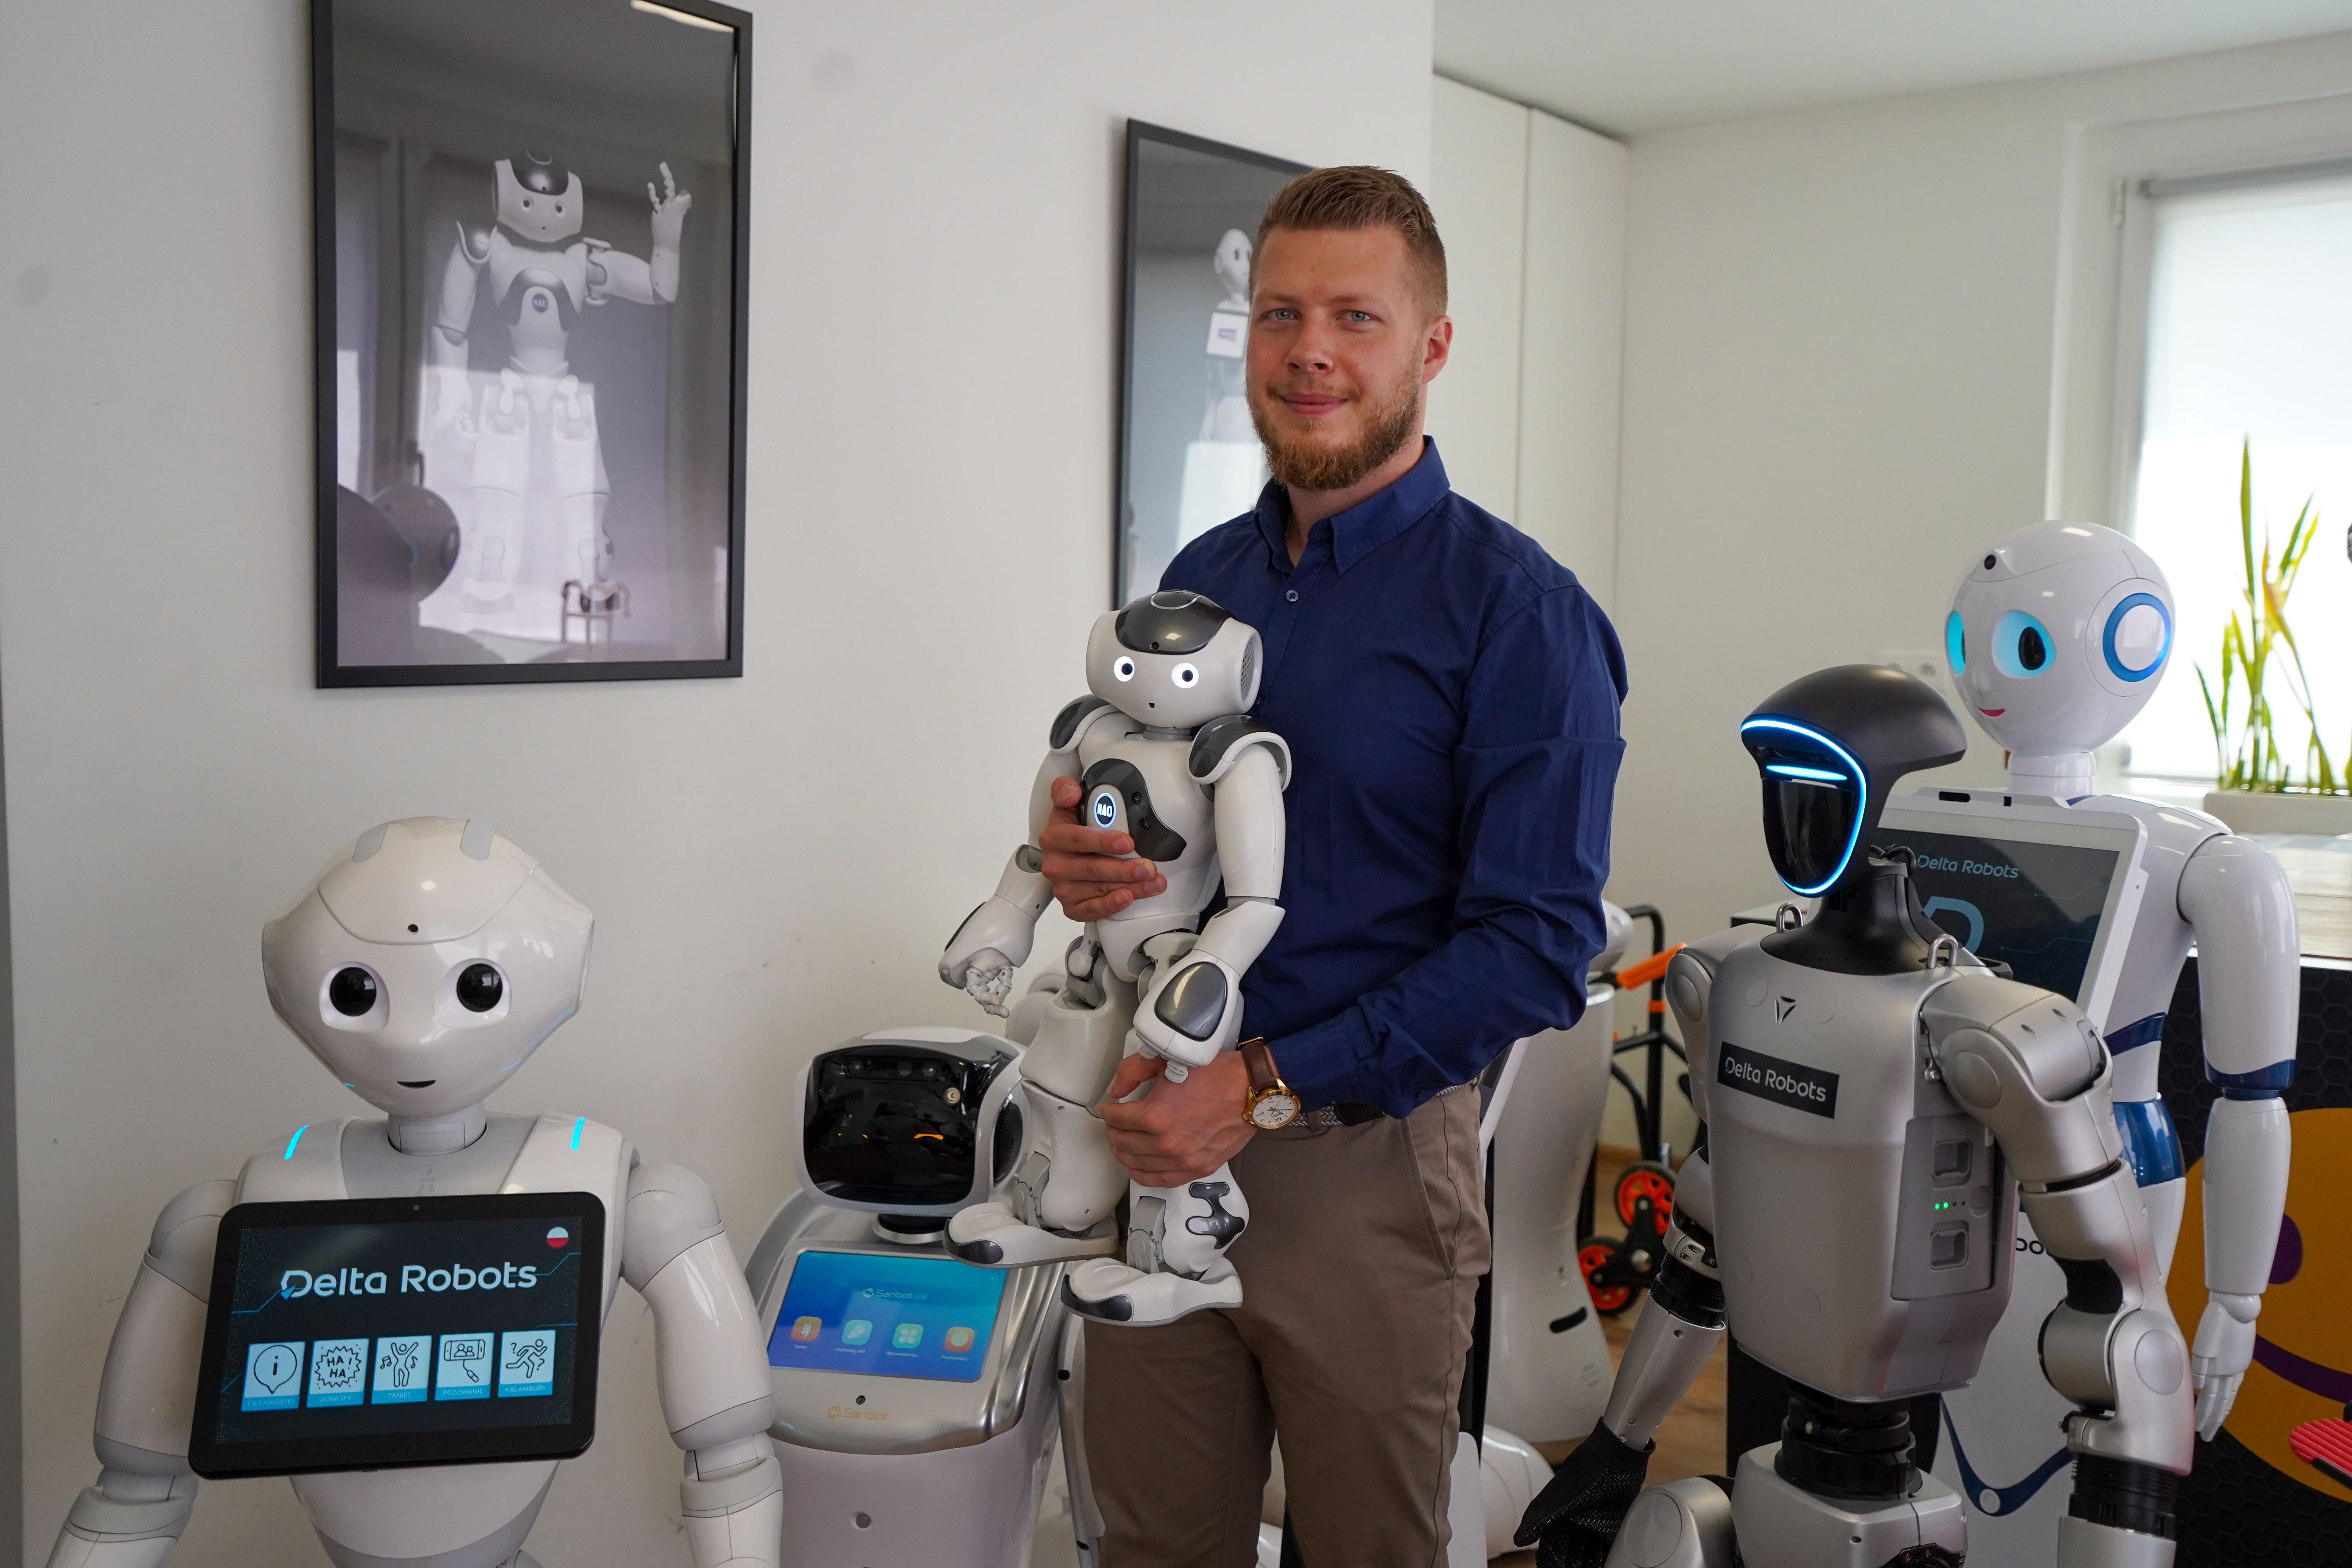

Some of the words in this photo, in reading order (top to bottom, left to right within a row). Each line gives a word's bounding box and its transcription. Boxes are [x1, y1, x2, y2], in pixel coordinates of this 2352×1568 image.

[1097, 803, 1112, 817] NAO
[1917, 855, 1958, 871] Delta
[1962, 860, 2019, 878] Robots
[1725, 1056, 1761, 1083] Delta
[1765, 1069, 1826, 1102] Robots
[281, 1268, 387, 1299] Delta
[401, 1261, 537, 1293] Robots
[875, 1290, 912, 1299] Sanbot
[327, 1355, 344, 1367] HA
[330, 1368, 346, 1378] HA
[843, 1408, 888, 1420] Sanbot
